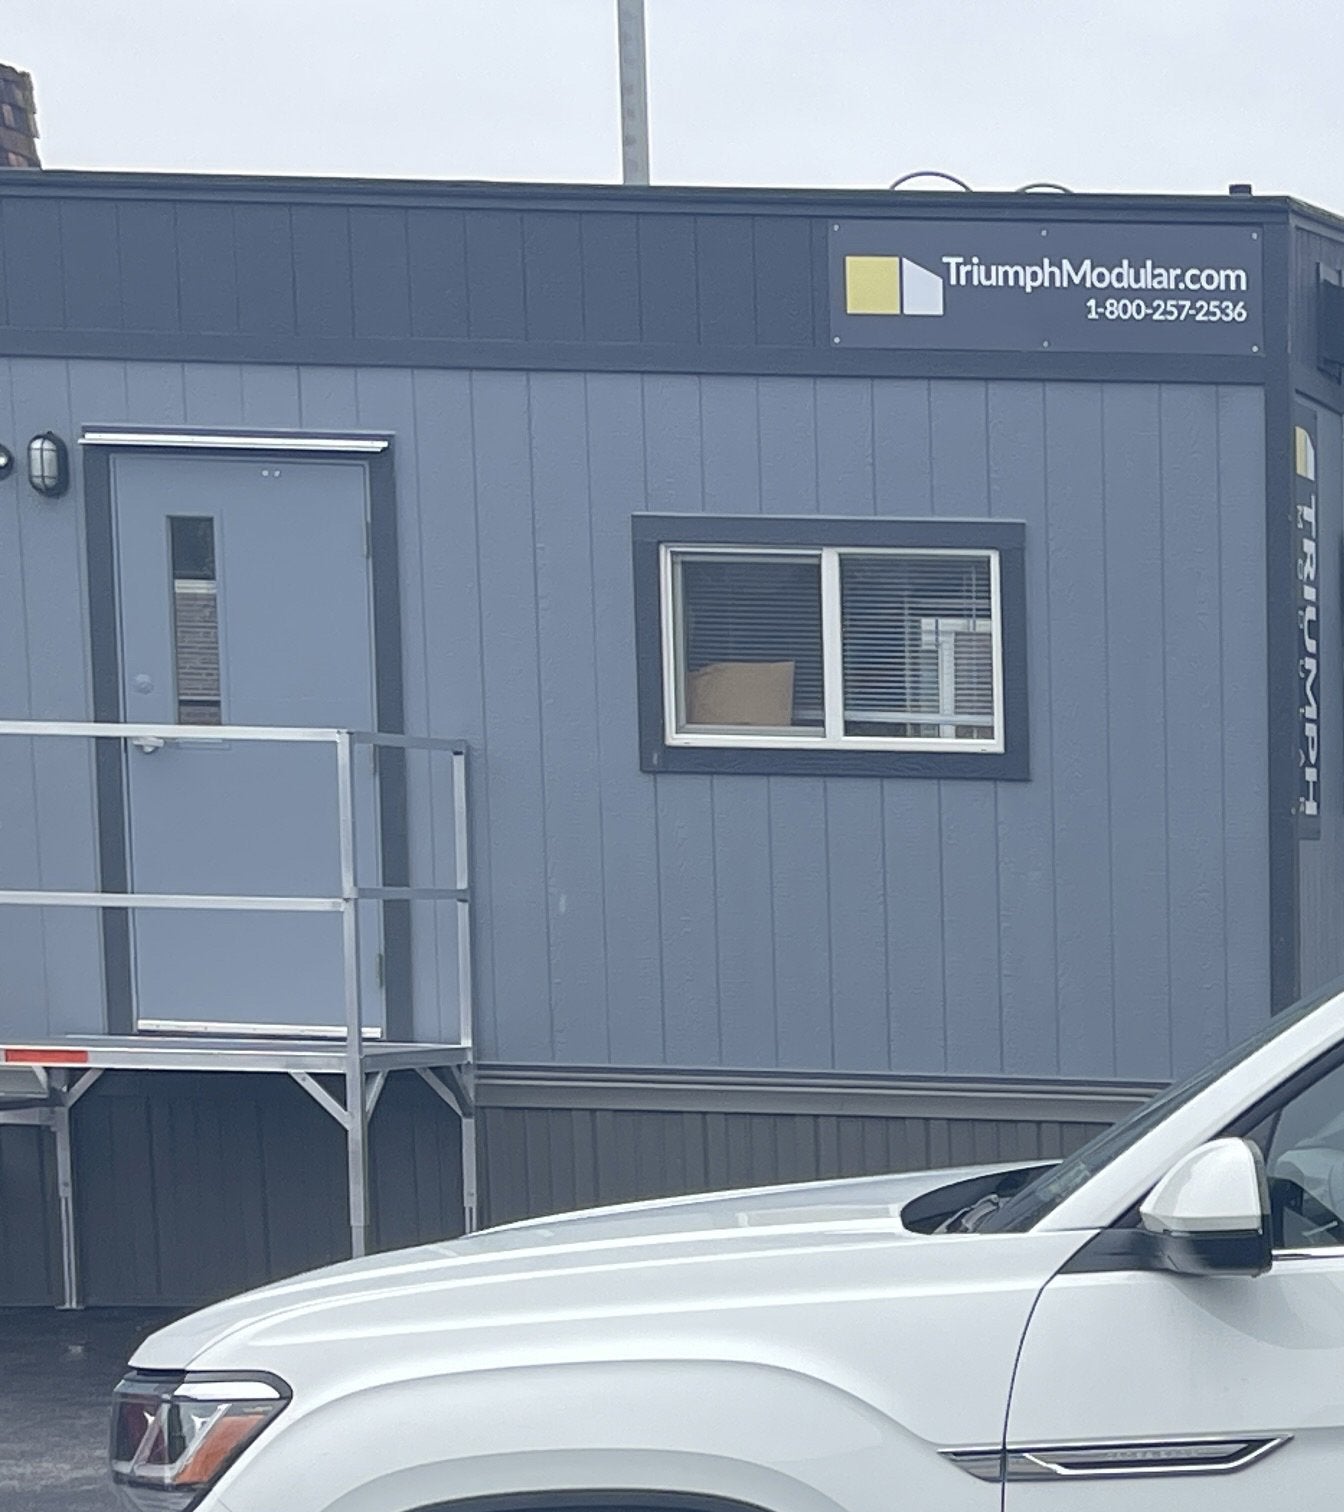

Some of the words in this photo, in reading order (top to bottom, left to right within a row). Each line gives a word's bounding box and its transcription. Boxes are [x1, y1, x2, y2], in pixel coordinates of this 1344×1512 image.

[942, 256, 1247, 292] TriumphModular.com
[1086, 299, 1247, 321] 1-800-257-2536
[1303, 494, 1317, 815] TRIUMPH
